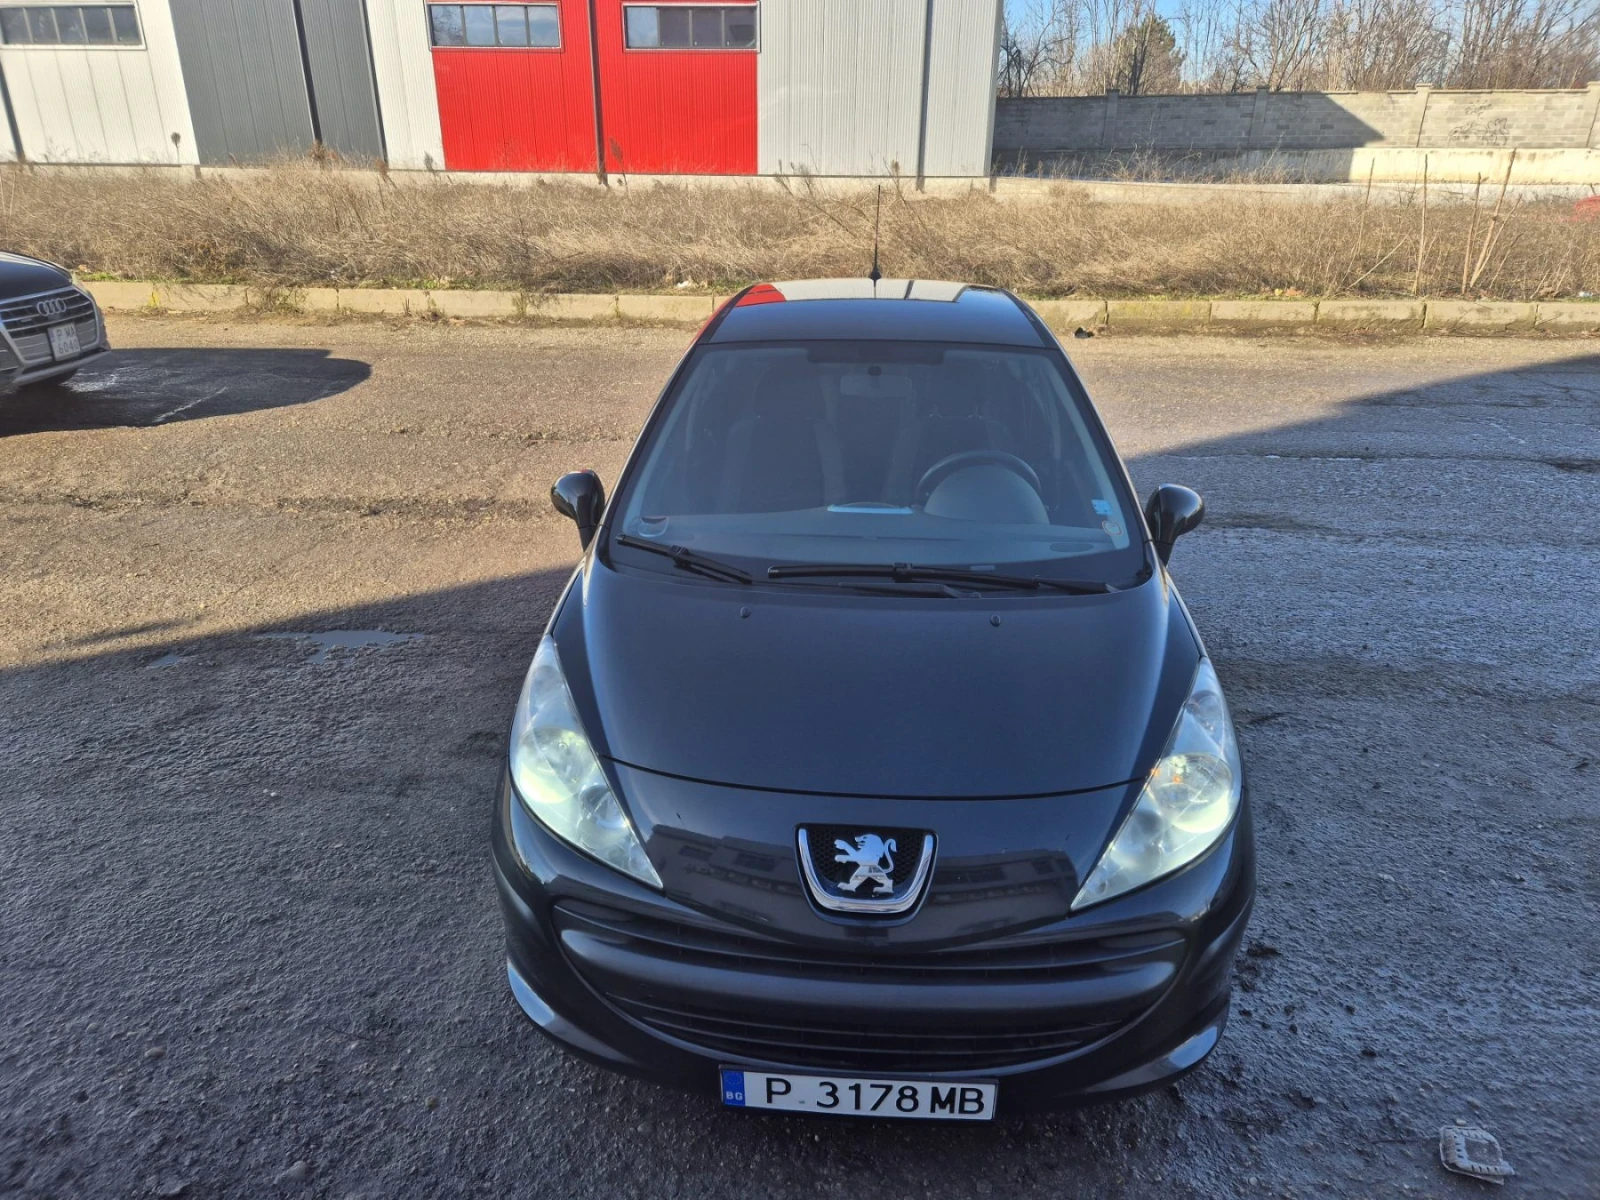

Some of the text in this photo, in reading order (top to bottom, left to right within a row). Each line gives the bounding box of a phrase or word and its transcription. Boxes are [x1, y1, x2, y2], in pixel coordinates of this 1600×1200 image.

[726, 1091, 743, 1101] BG
[766, 1077, 792, 1104] P
[816, 1081, 920, 1113] 3178
